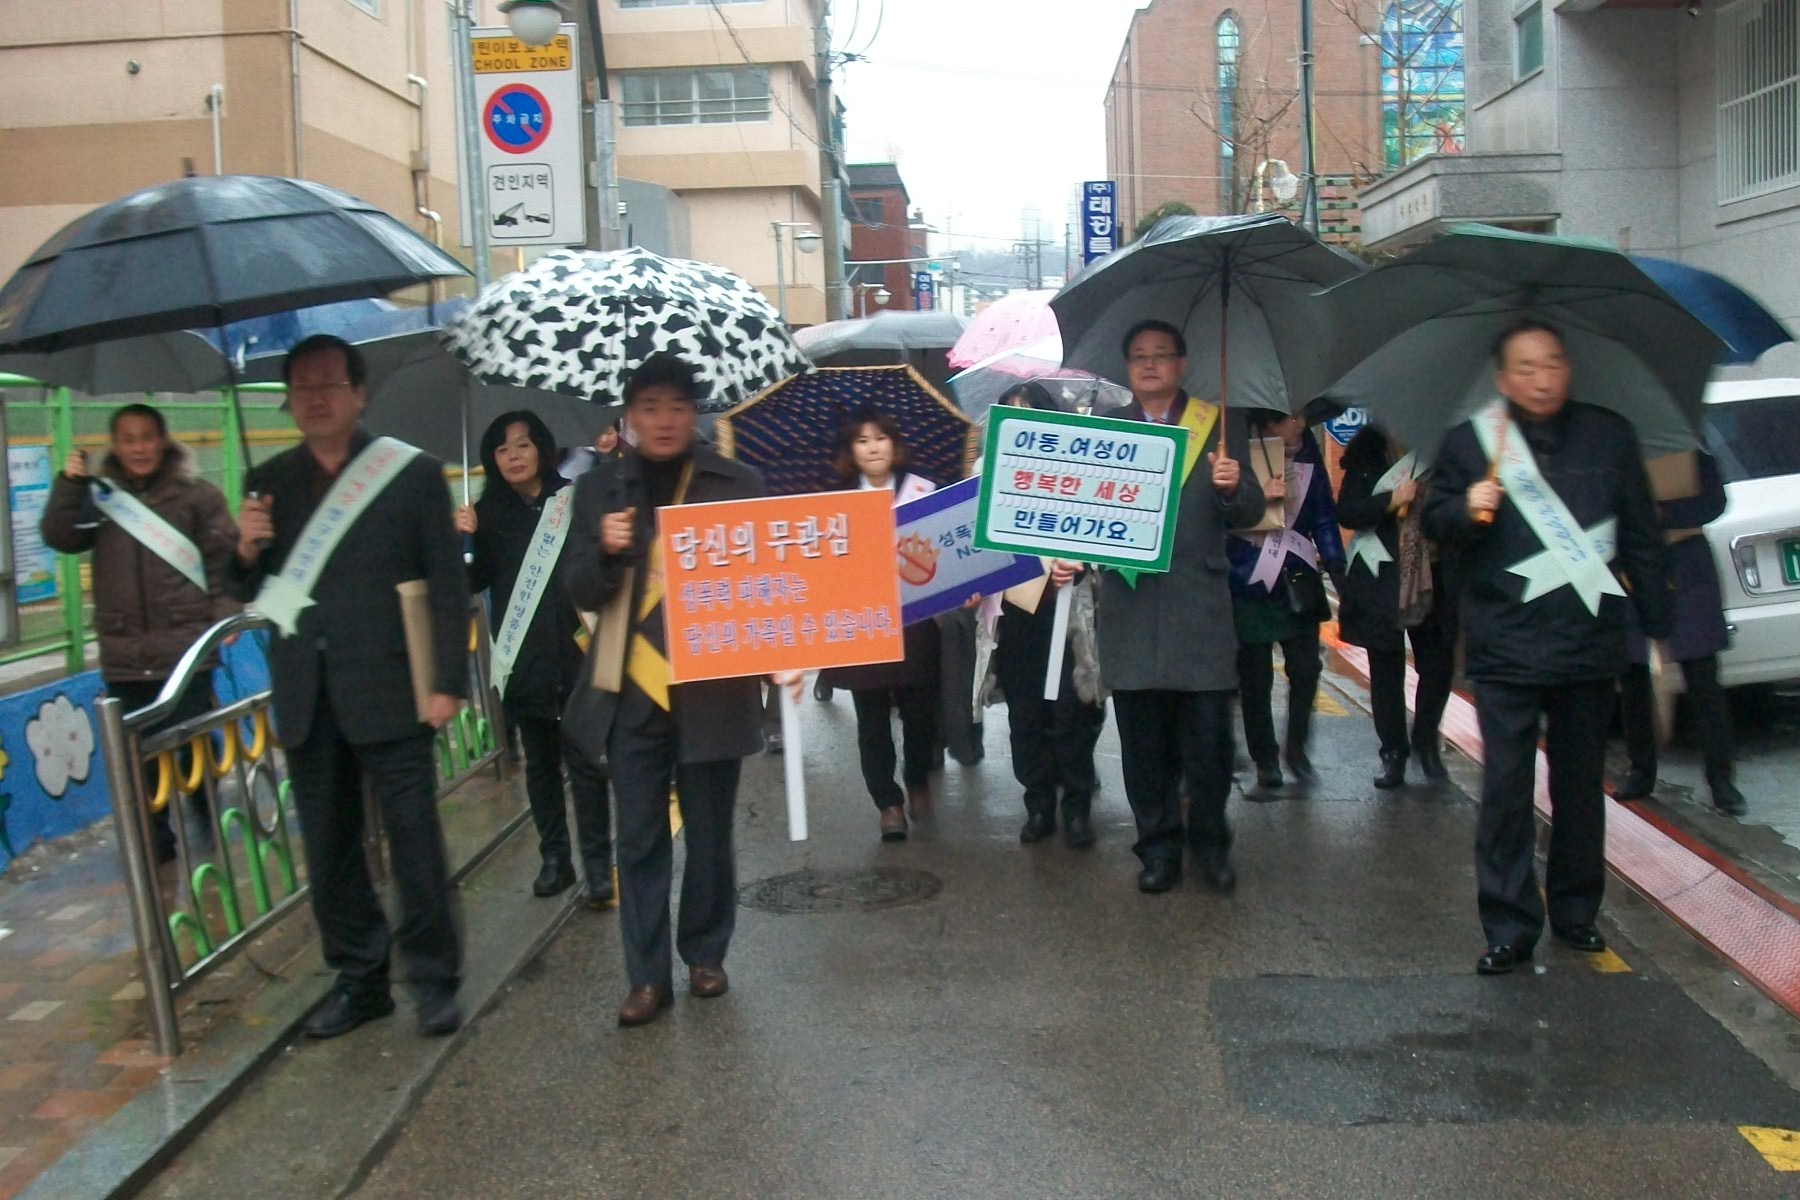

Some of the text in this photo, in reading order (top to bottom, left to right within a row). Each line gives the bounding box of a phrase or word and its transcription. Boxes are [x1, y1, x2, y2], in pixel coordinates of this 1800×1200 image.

[474, 56, 566, 71] CHOOL ZONE
[493, 173, 549, 191] 견인지역
[1013, 470, 1141, 503] 행복한 세상
[670, 512, 849, 570] 당신의 무관심
[938, 520, 976, 547] 성폭
[1014, 510, 1135, 543] 만들어가요.
[738, 572, 808, 607] 피해자는
[683, 605, 898, 656] 당신의 가족일 수 있습니다.
